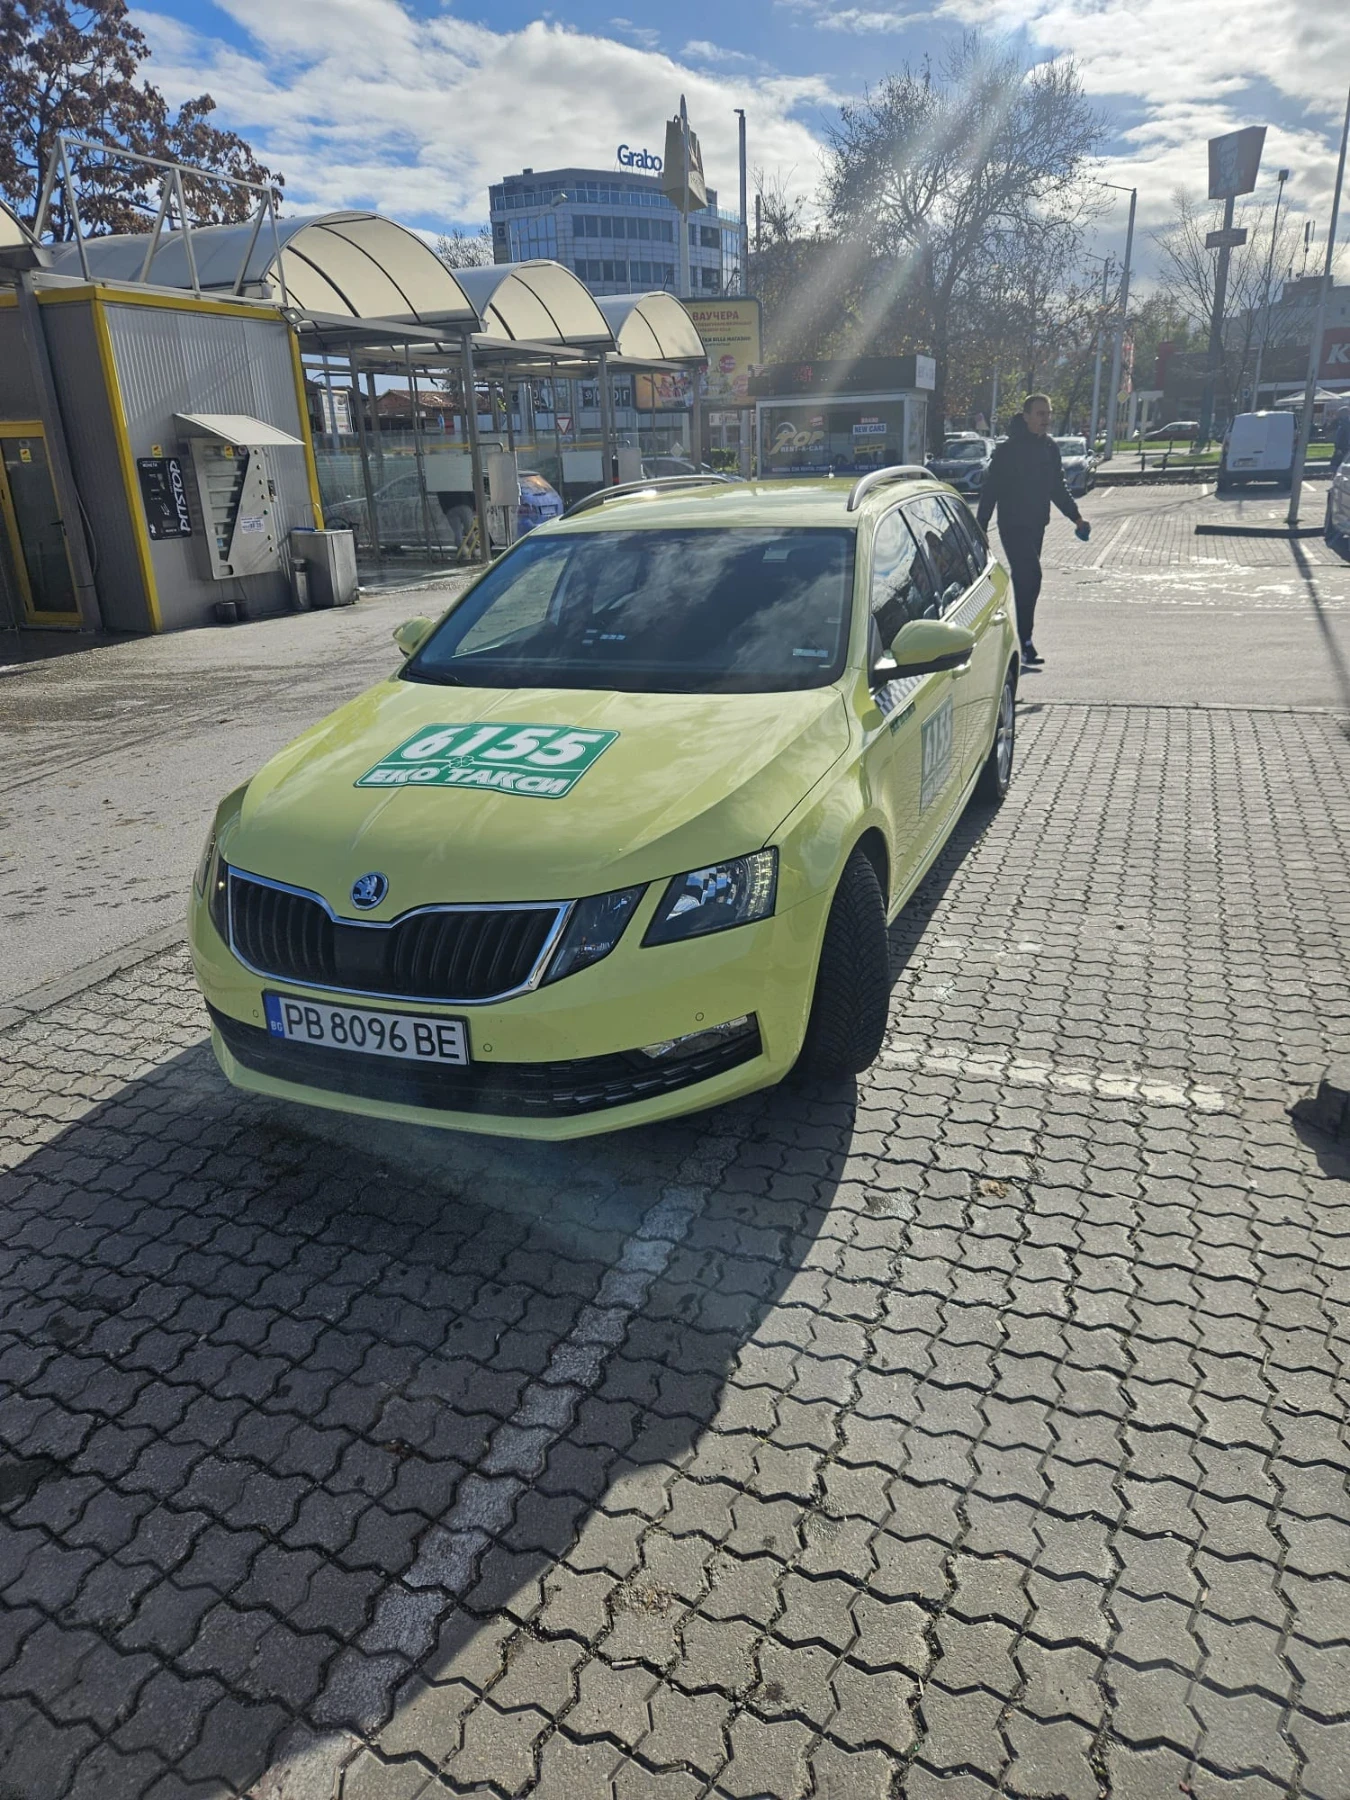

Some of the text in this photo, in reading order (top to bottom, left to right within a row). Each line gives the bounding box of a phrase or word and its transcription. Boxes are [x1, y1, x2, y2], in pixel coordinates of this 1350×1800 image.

[617, 144, 663, 171] Grabo
[692, 311, 740, 321] ВАУЧЕРА
[855, 424, 886, 433] NEW CARS
[769, 431, 825, 455] TOP
[169, 460, 192, 532] PITSTOP
[401, 726, 605, 766] 6155
[361, 767, 571, 795] ЕКО ТАКСИ
[270, 1020, 283, 1032] BG
[284, 1003, 460, 1060] PB 8096 BE
